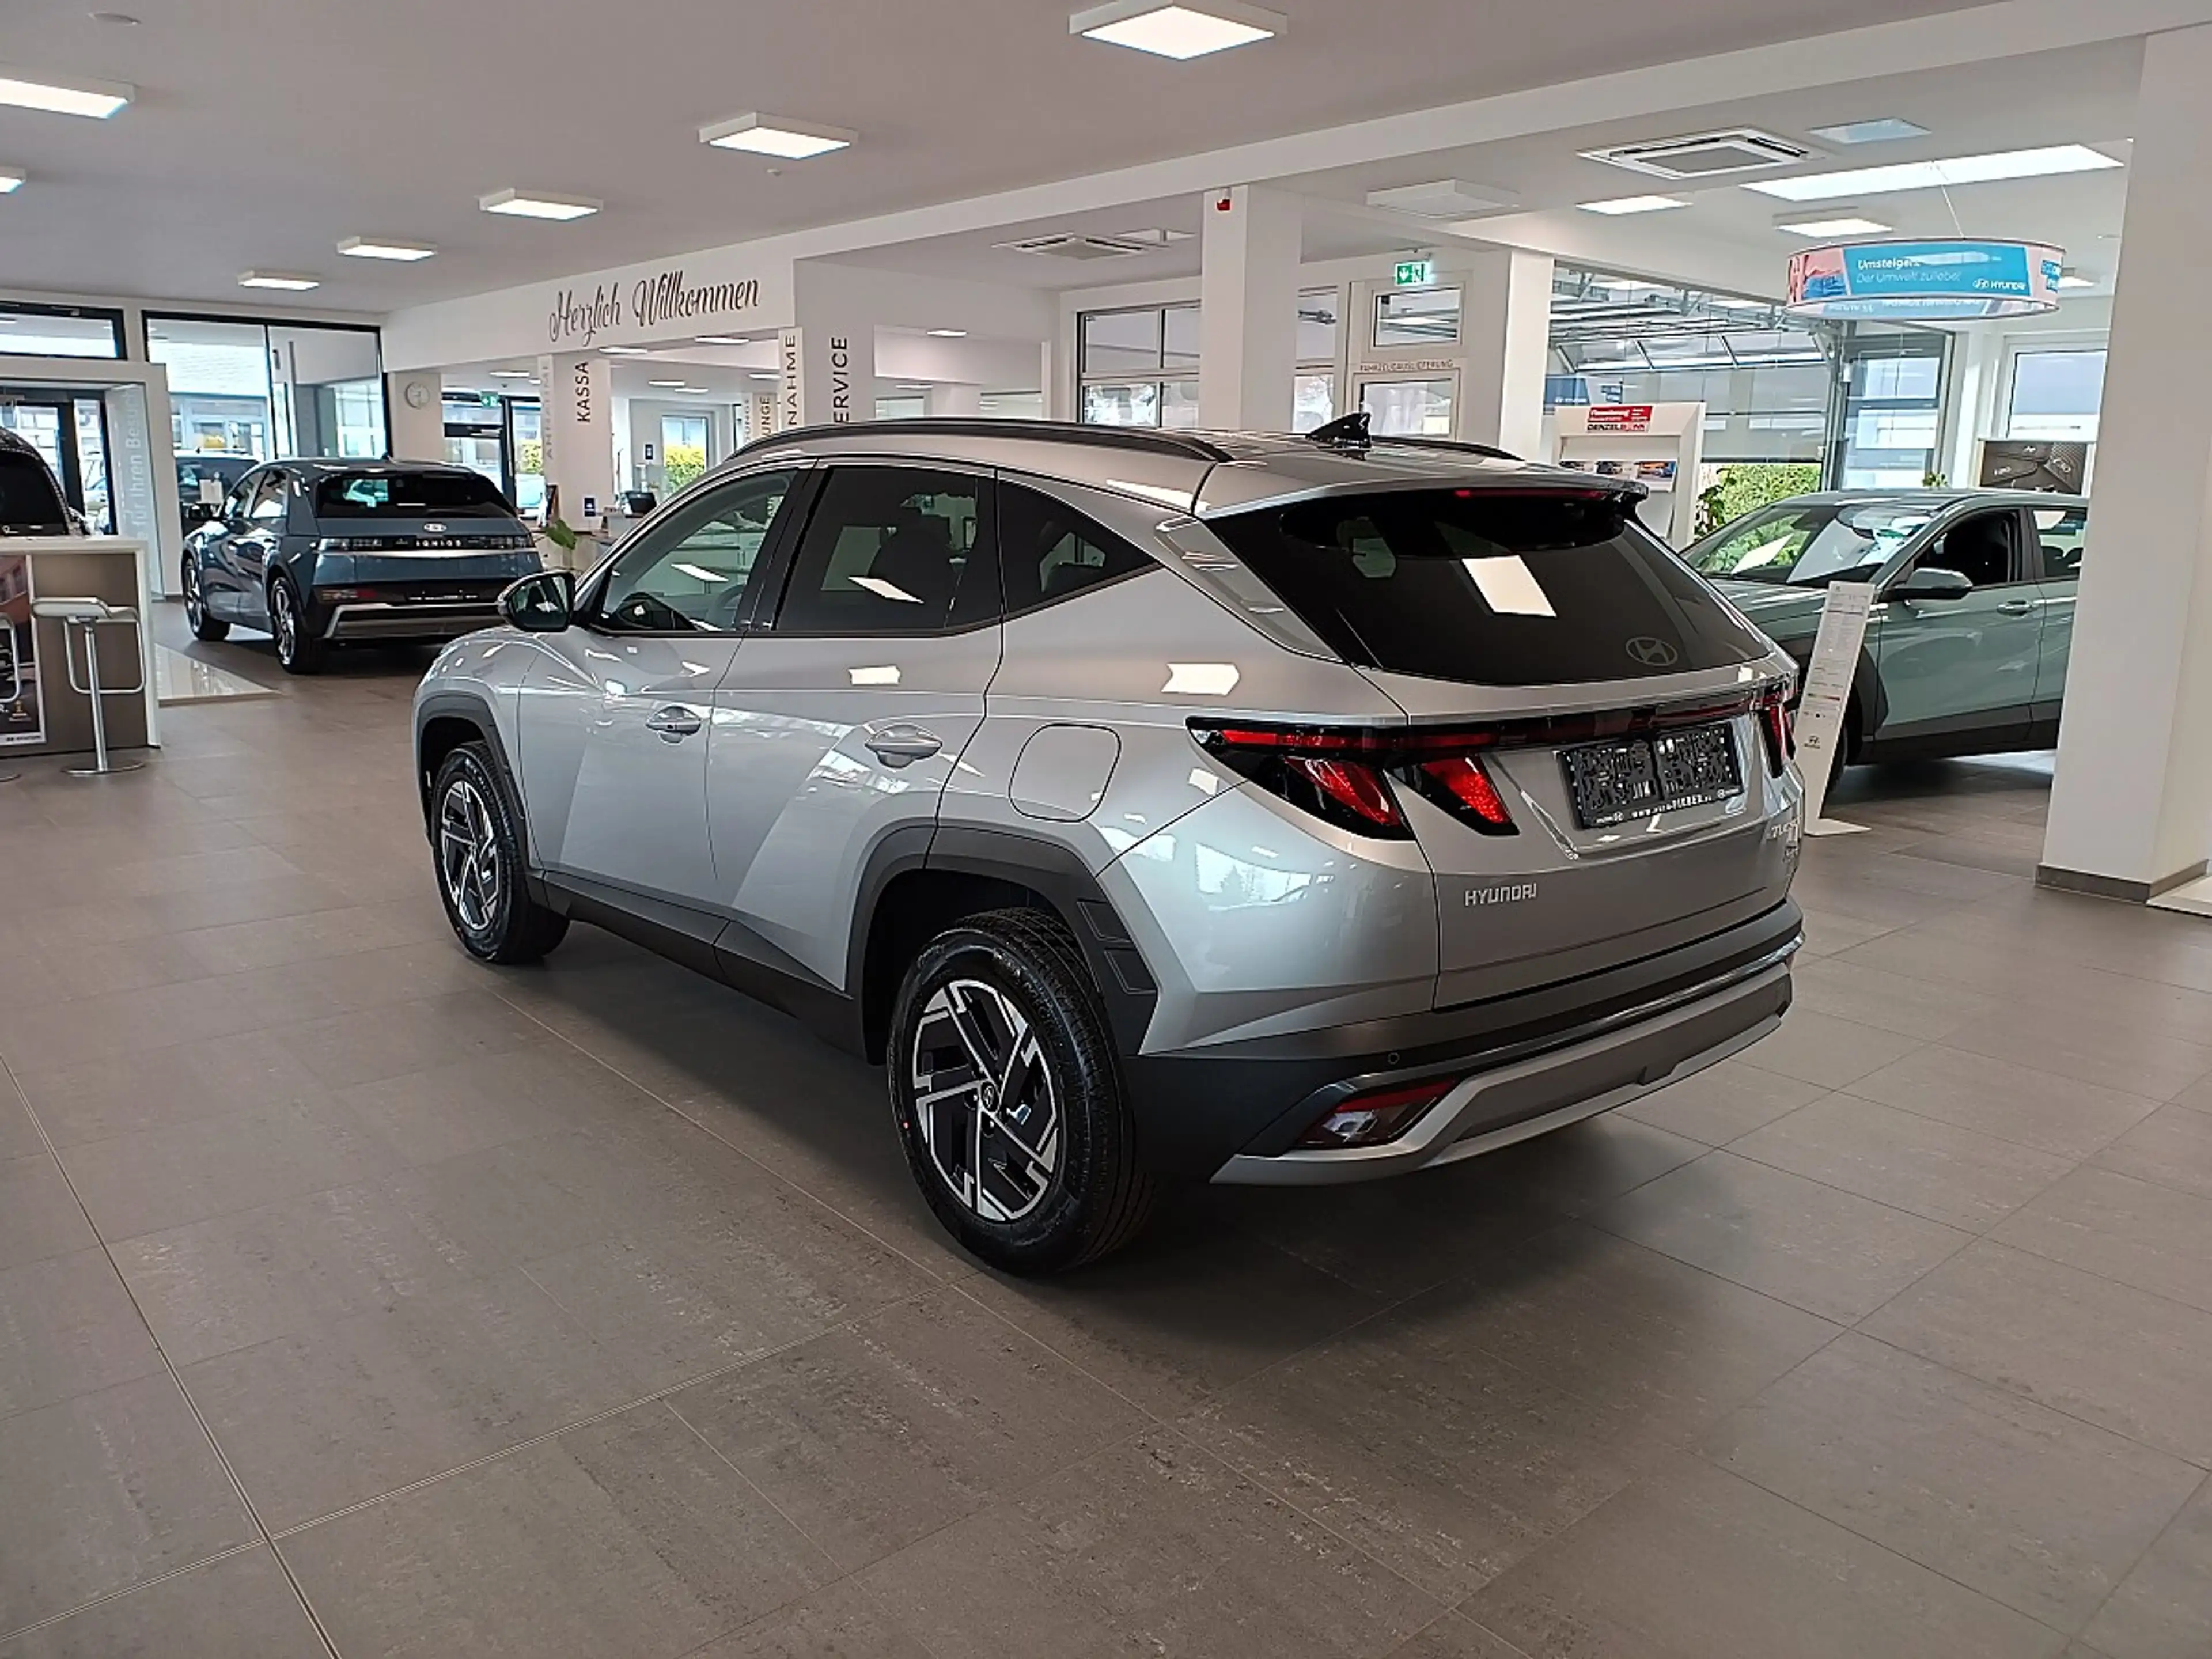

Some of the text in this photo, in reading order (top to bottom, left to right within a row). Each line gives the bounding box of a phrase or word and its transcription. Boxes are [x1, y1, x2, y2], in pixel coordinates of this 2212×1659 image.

[549, 270, 759, 347] Herzlich Willkommen
[574, 361, 590, 423] KASSA
[128, 454, 146, 497] Ihren
[1465, 882, 1537, 906] HYUNDAI
